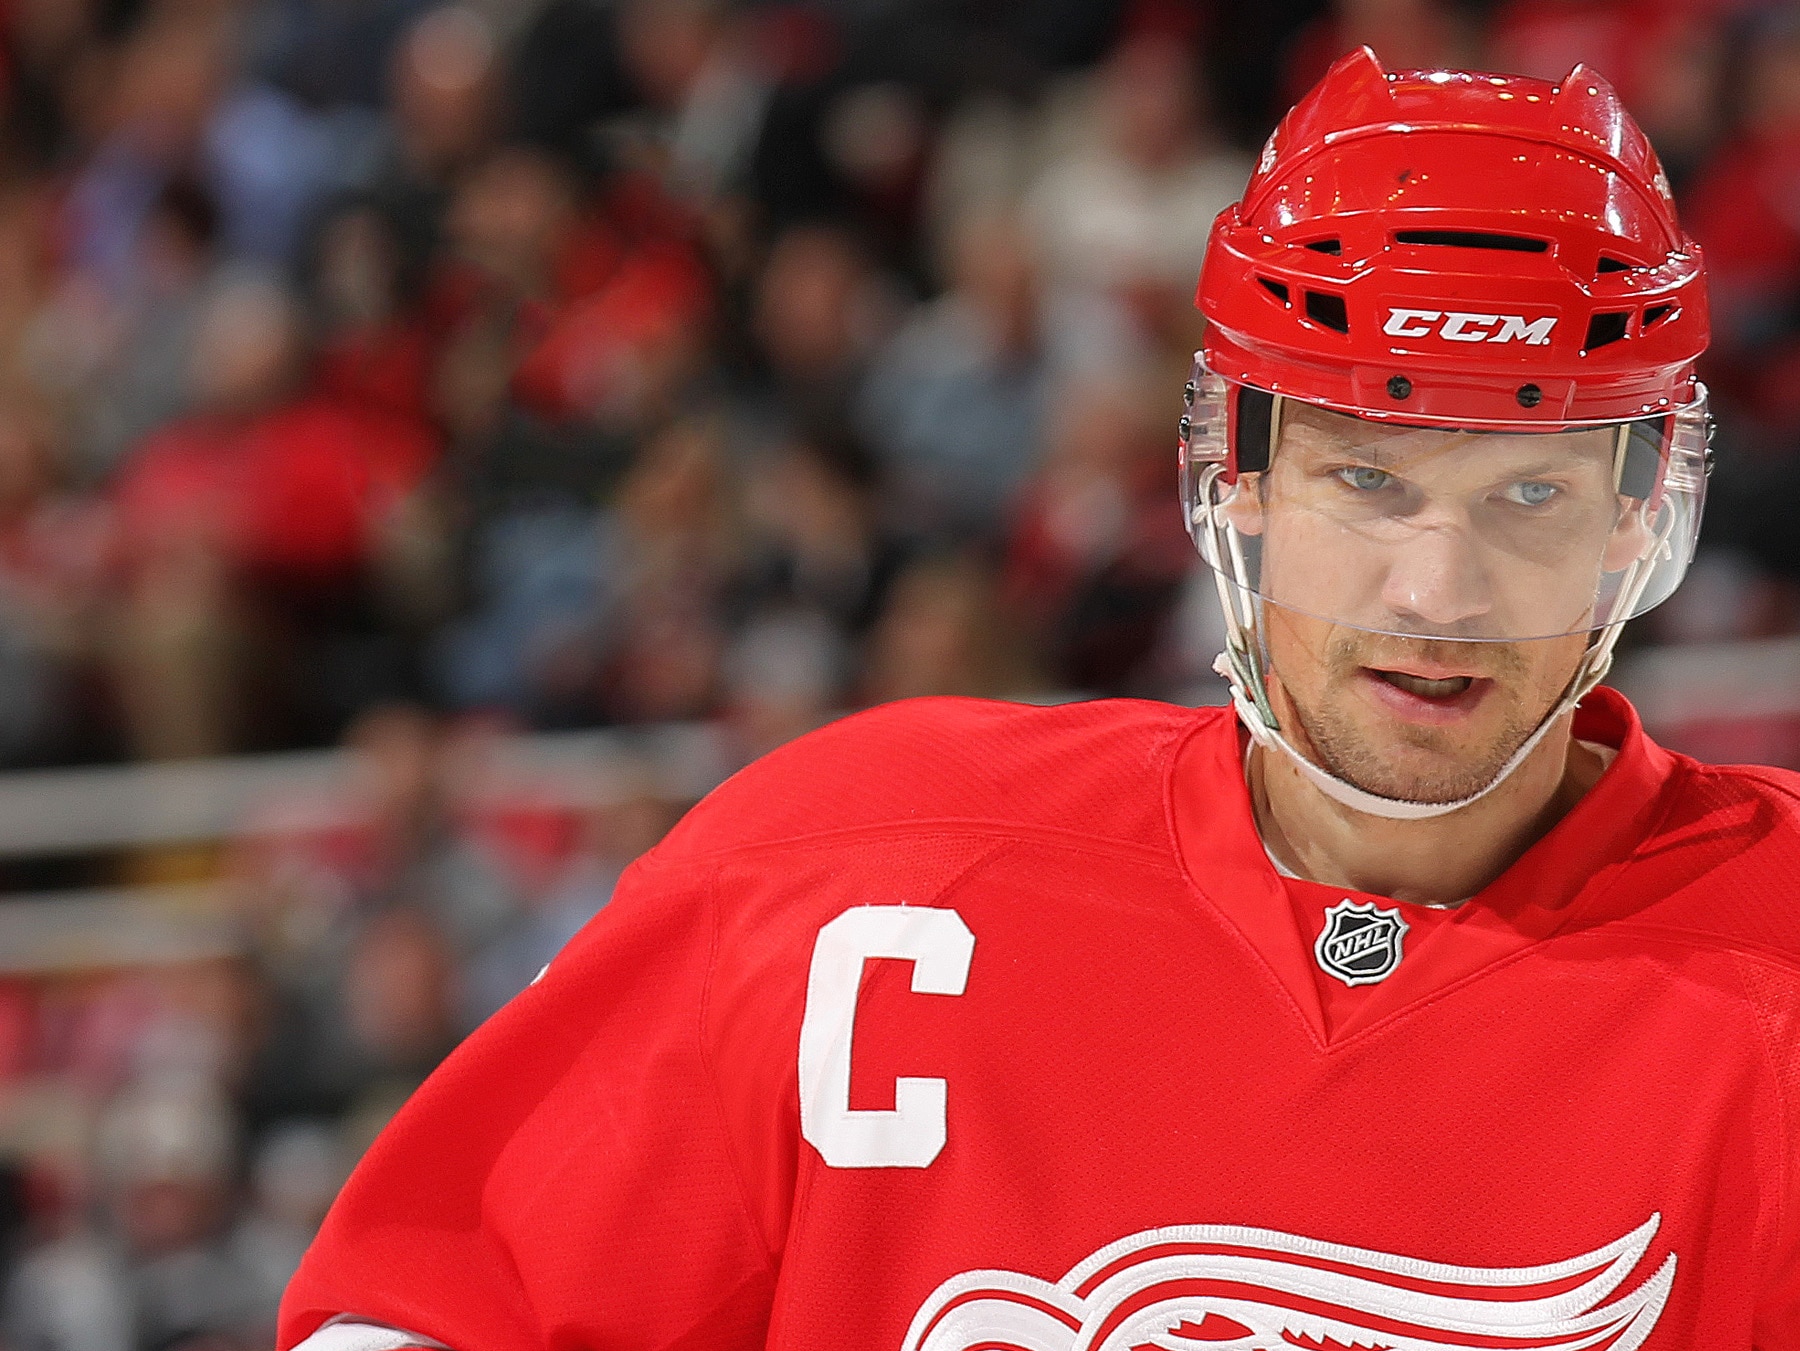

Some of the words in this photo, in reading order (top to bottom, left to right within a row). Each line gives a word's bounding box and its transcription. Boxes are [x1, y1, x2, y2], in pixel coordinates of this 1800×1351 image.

[1383, 306, 1557, 345] CCM
[1334, 926, 1388, 961] NHL
[798, 905, 975, 1168] C
